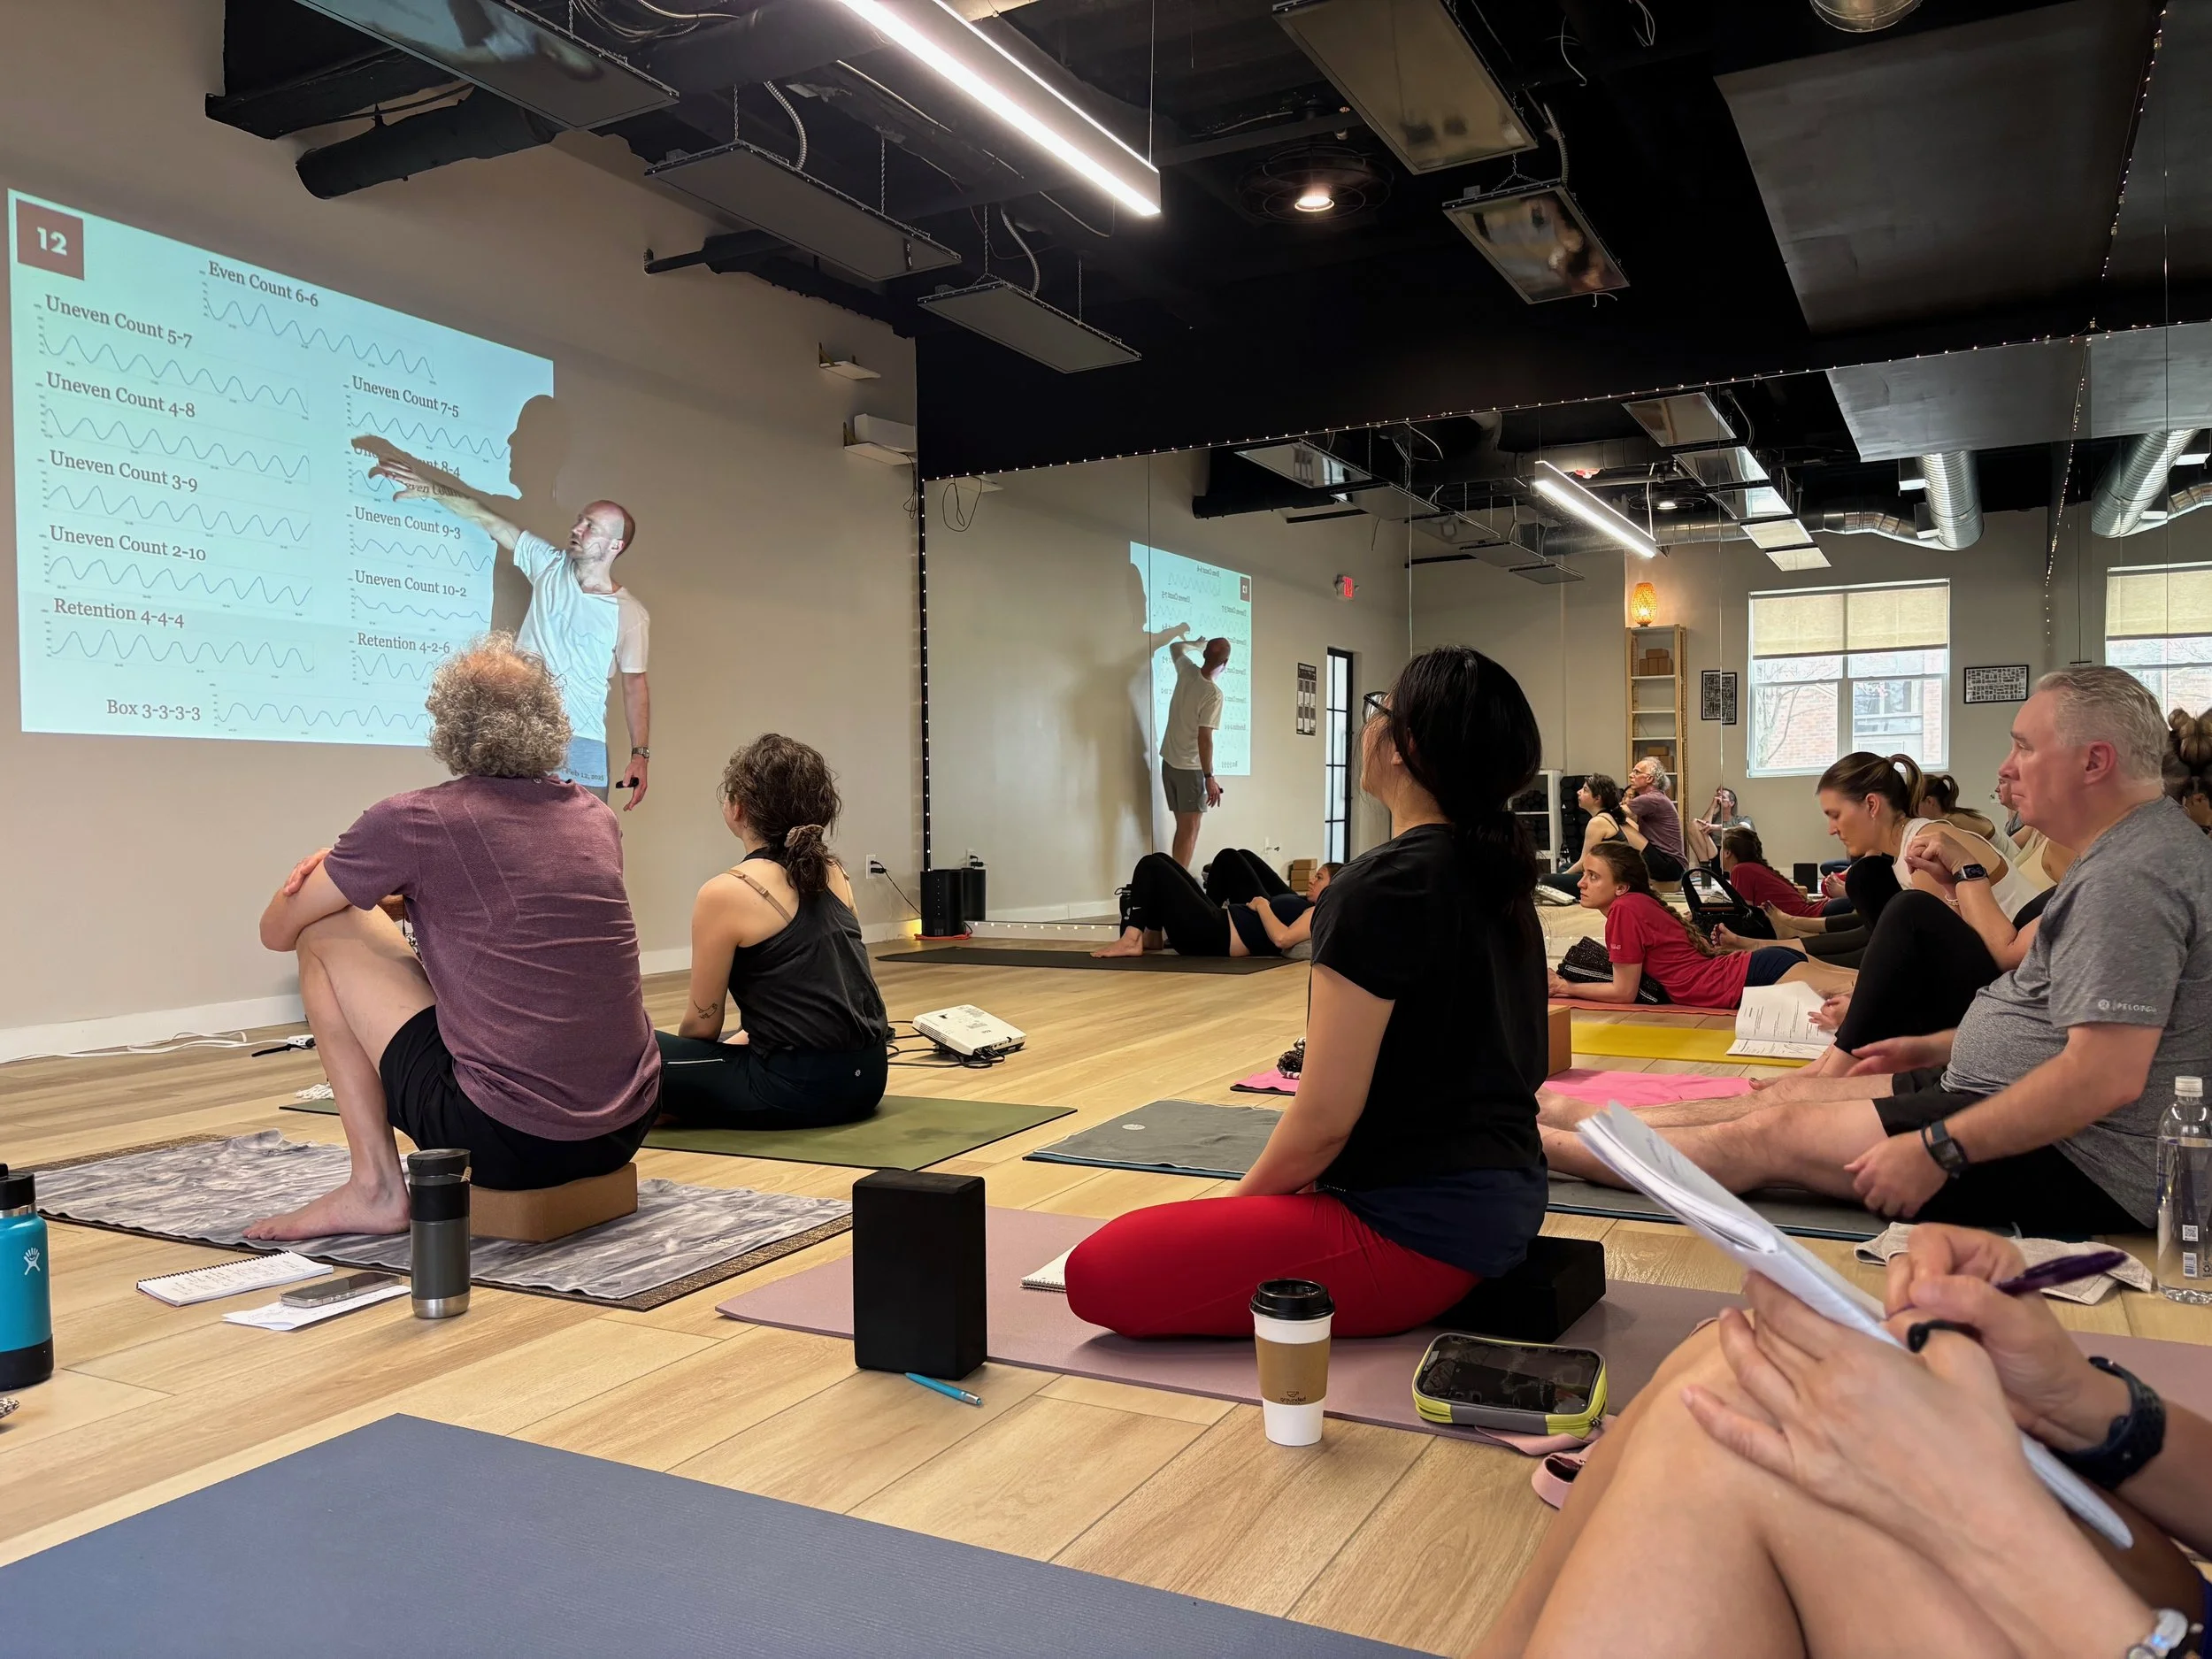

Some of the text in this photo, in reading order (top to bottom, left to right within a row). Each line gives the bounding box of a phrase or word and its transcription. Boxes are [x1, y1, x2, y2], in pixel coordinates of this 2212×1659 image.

[36, 227, 67, 256] 12
[208, 260, 319, 307] Even Count 6-6
[45, 294, 192, 349] Uneven Count 5-7
[46, 371, 196, 418] Uneven Count 4-8
[352, 374, 459, 418] Uneven Count 7-5
[50, 449, 198, 493] Uneven Count 3-9
[442, 460, 460, 479] 8-4
[354, 505, 461, 540] Uneven Count 9-3
[50, 524, 207, 562] Uneven Count 2-10
[354, 569, 467, 597] Uneven Count 10-2
[54, 597, 185, 629] Retention 4-4-4
[357, 632, 450, 655] Retention 4-2-6
[106, 699, 201, 721] Box 3-3-3-3
